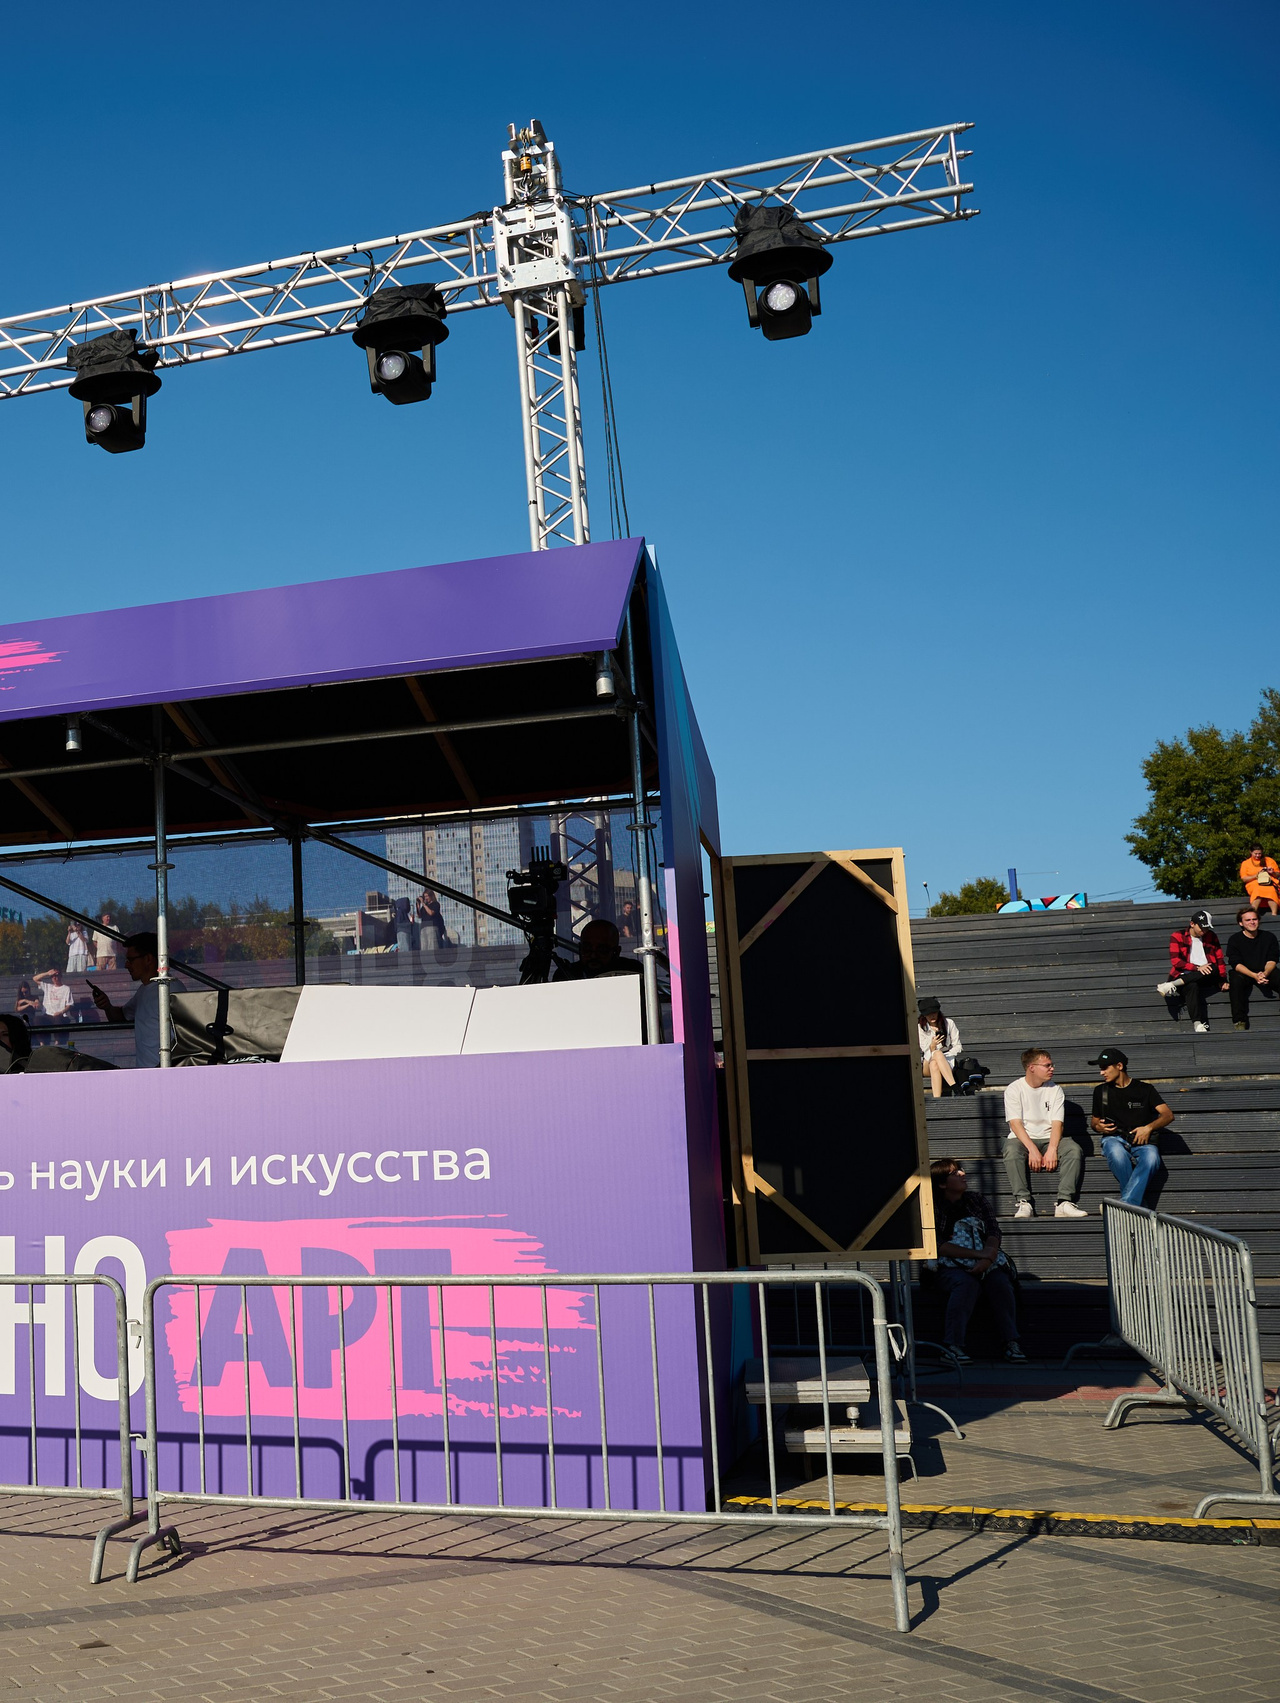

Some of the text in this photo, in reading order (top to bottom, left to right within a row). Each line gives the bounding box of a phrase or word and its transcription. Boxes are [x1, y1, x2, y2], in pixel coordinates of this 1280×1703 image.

[30, 1156, 167, 1201] науки
[185, 1156, 212, 1187] и
[230, 1146, 491, 1197] искусства
[190, 1246, 453, 1389] АРТ
